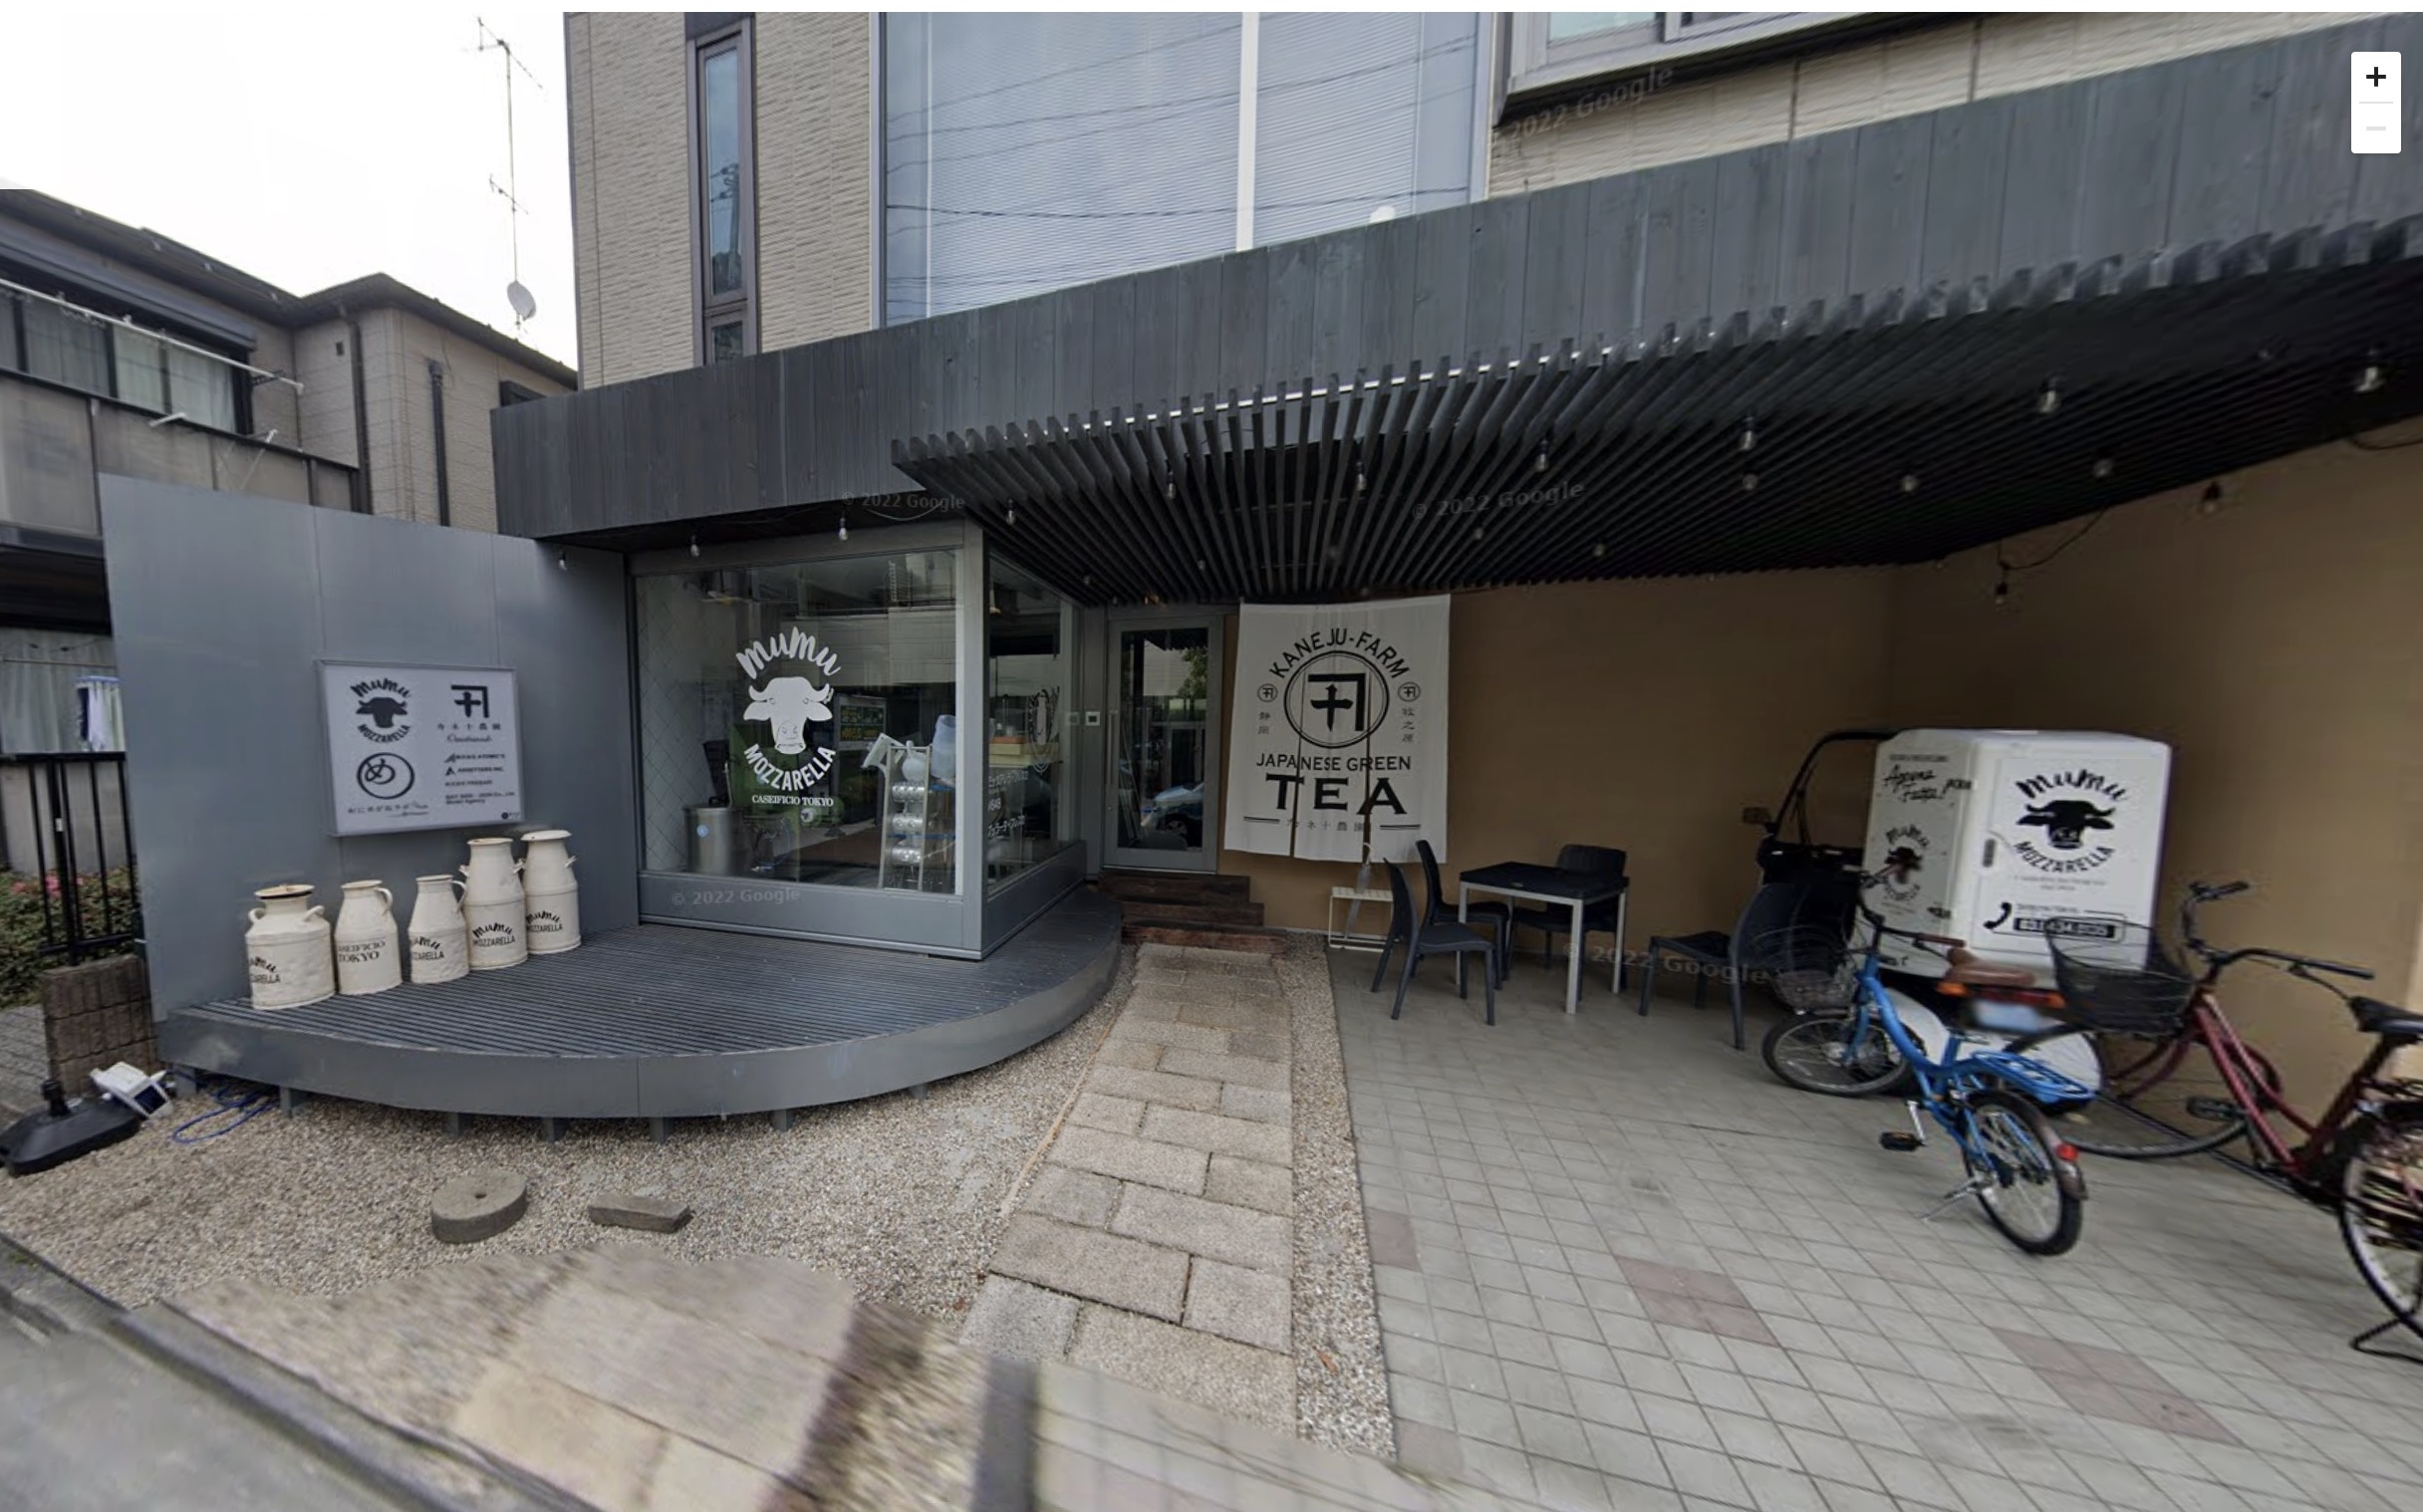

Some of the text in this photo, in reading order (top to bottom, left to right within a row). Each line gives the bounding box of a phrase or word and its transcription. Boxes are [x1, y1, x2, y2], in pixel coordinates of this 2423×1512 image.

[1268, 628, 1411, 679] KANEJU-FARM
[357, 724, 411, 744] MOZZARELLA
[743, 743, 837, 792] MOZZARELLA
[1256, 753, 1412, 772] JAPANESE GREEN
[752, 794, 835, 807] CASEIFICIO TOKYO
[1265, 772, 1408, 816] TEA
[2014, 840, 2116, 875] MOZZARELLA
[340, 951, 381, 964] TOKYO
